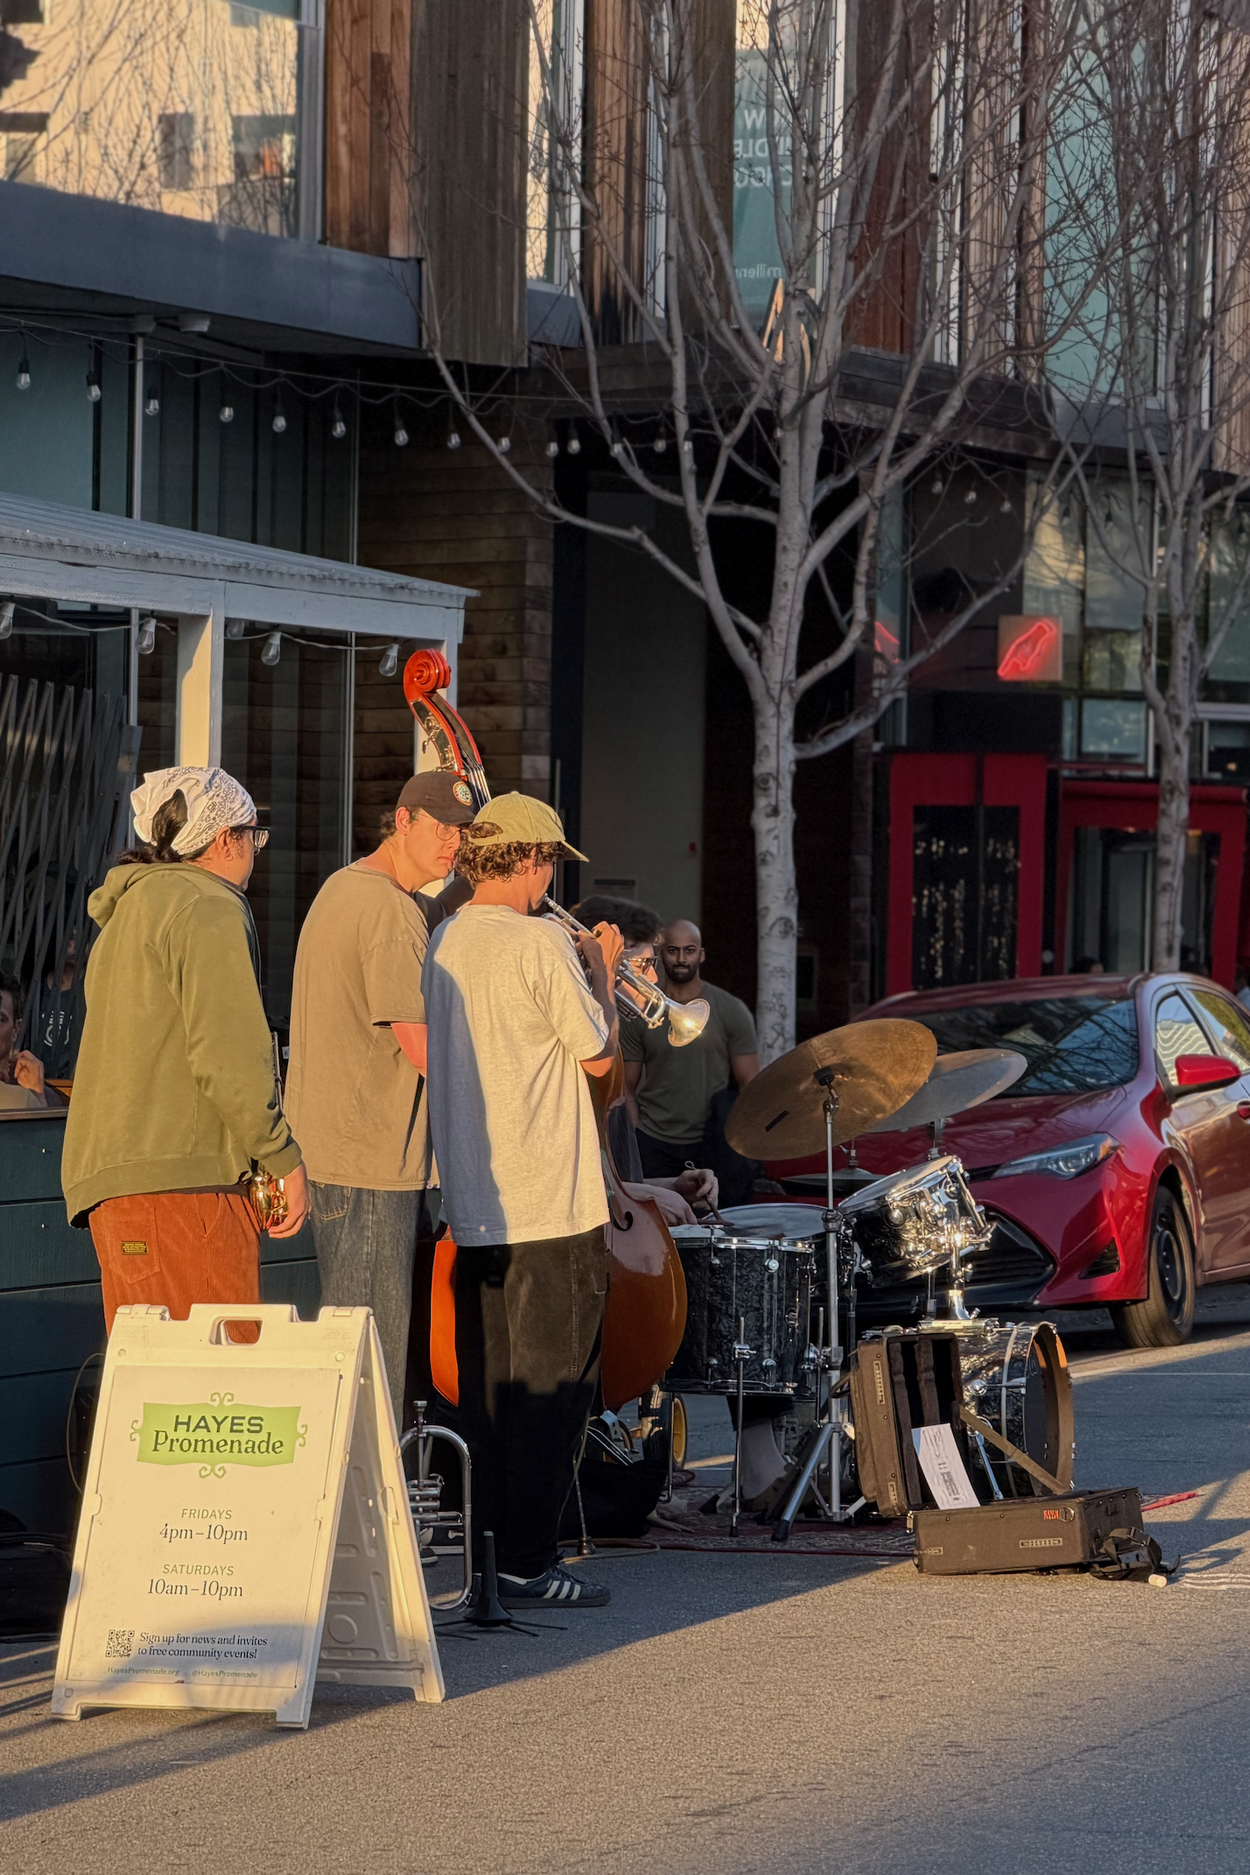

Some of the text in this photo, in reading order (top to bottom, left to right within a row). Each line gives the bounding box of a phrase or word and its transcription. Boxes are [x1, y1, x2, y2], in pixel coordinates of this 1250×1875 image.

[173, 1415, 264, 1434] HAYES
[151, 1430, 285, 1455] Promenade
[181, 1508, 232, 1520] FRIDAYS
[162, 1564, 234, 1576] SATURDAYS
[139, 1631, 268, 1646] Sign up for news and invites
[138, 1646, 258, 1660] to free community events!
[107, 1667, 258, 1678] HayesPromenade.org @HayesPromenade
